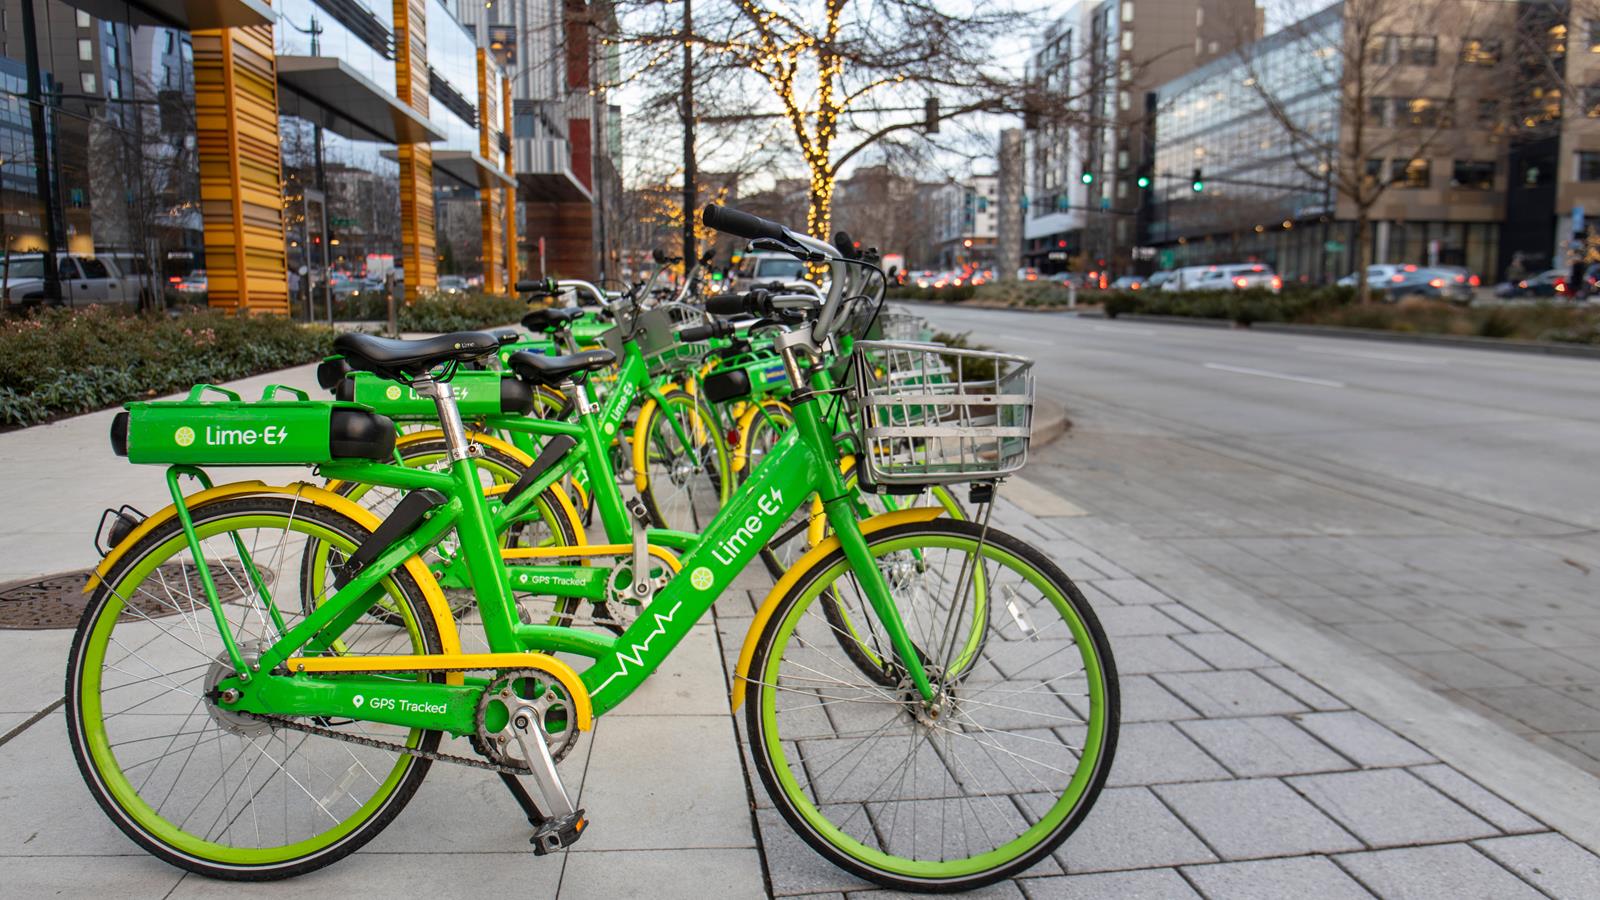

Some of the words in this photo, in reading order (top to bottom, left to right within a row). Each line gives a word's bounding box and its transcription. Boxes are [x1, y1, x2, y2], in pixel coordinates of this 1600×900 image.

[531, 575, 550, 585] GPS
[551, 576, 586, 586] Tracked
[369, 697, 396, 710] GPS
[399, 699, 448, 714] Tracked
